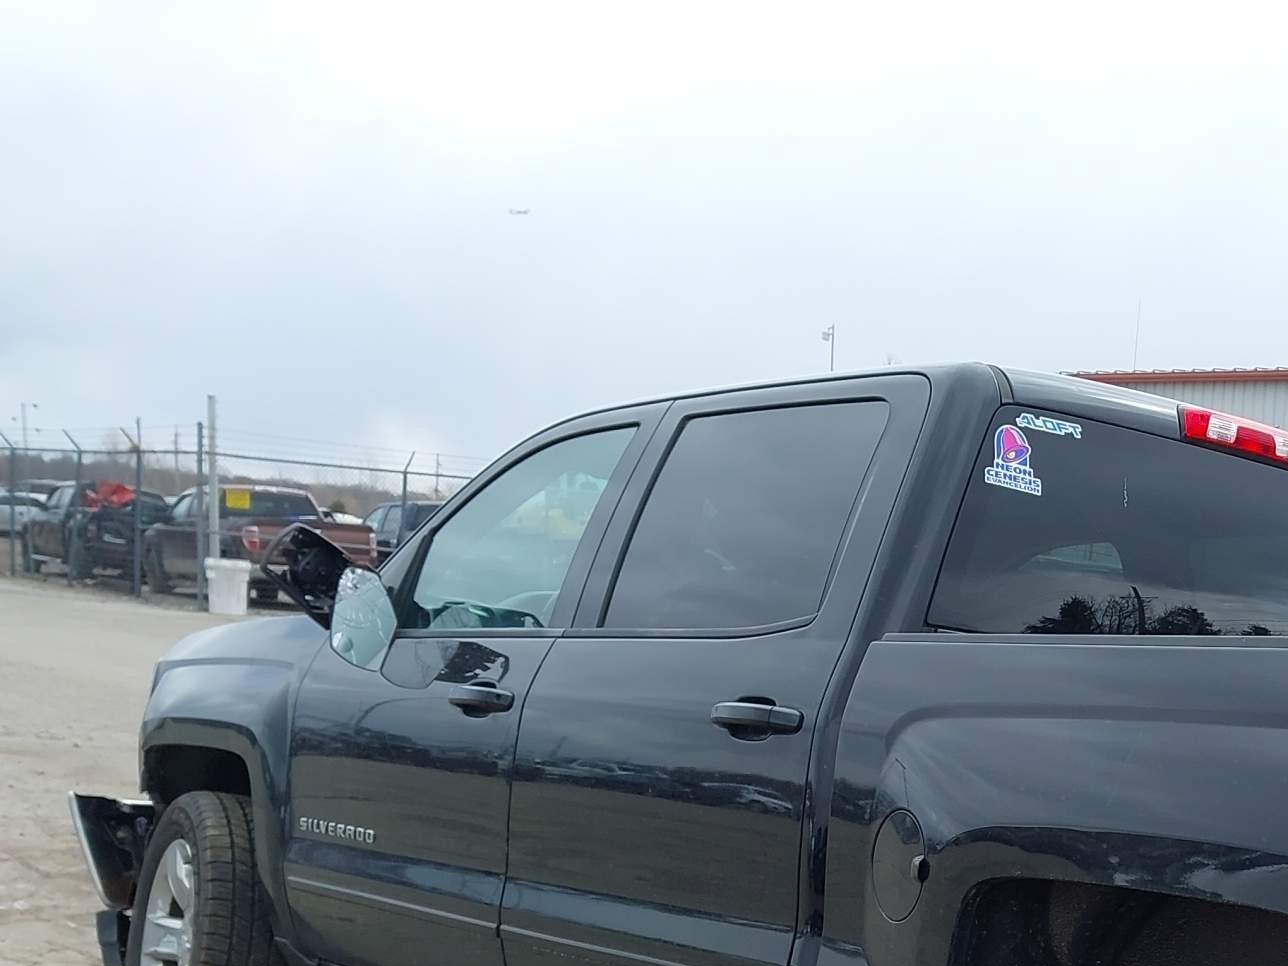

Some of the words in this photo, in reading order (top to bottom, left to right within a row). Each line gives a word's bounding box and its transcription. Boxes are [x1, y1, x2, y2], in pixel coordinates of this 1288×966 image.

[1018, 414, 1081, 438] ALOFT
[995, 462, 1033, 478] NEON
[299, 816, 375, 843] SILVERADO
